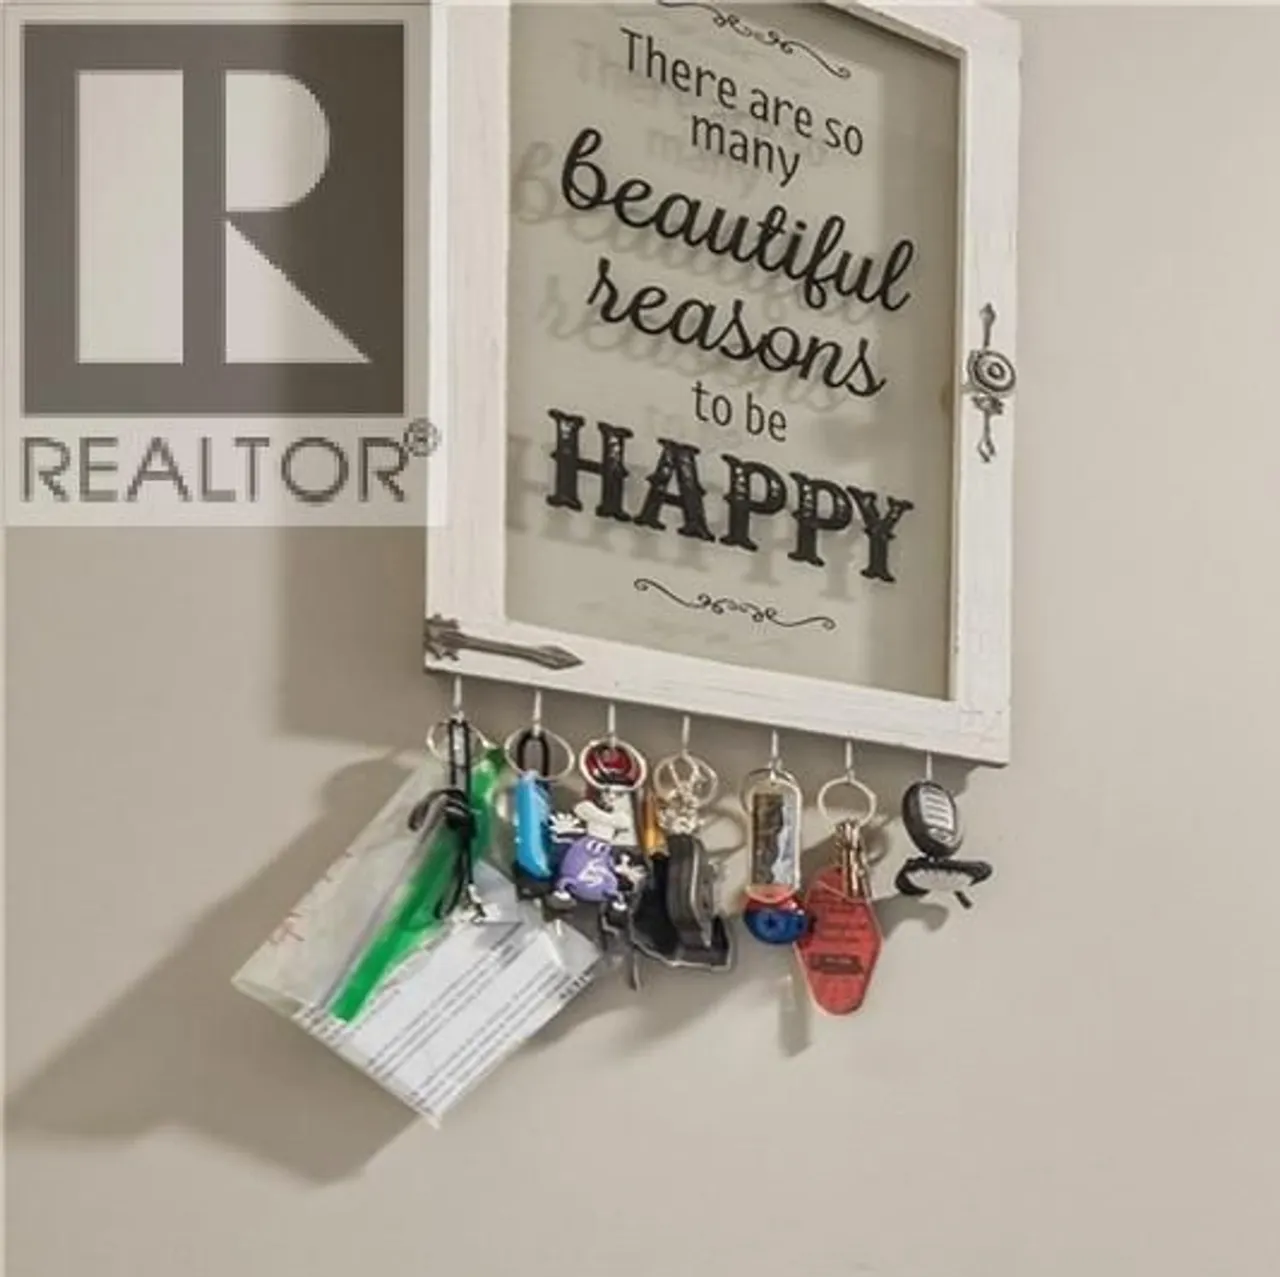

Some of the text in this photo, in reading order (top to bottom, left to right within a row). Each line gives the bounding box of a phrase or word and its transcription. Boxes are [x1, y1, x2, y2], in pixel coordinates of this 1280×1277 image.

[620, 27, 863, 156] There are so
[692, 115, 800, 188] many
[561, 128, 914, 310] beautiful
[587, 257, 886, 397] reasons
[691, 380, 788, 441] to be
[546, 408, 914, 583] HAPPY
